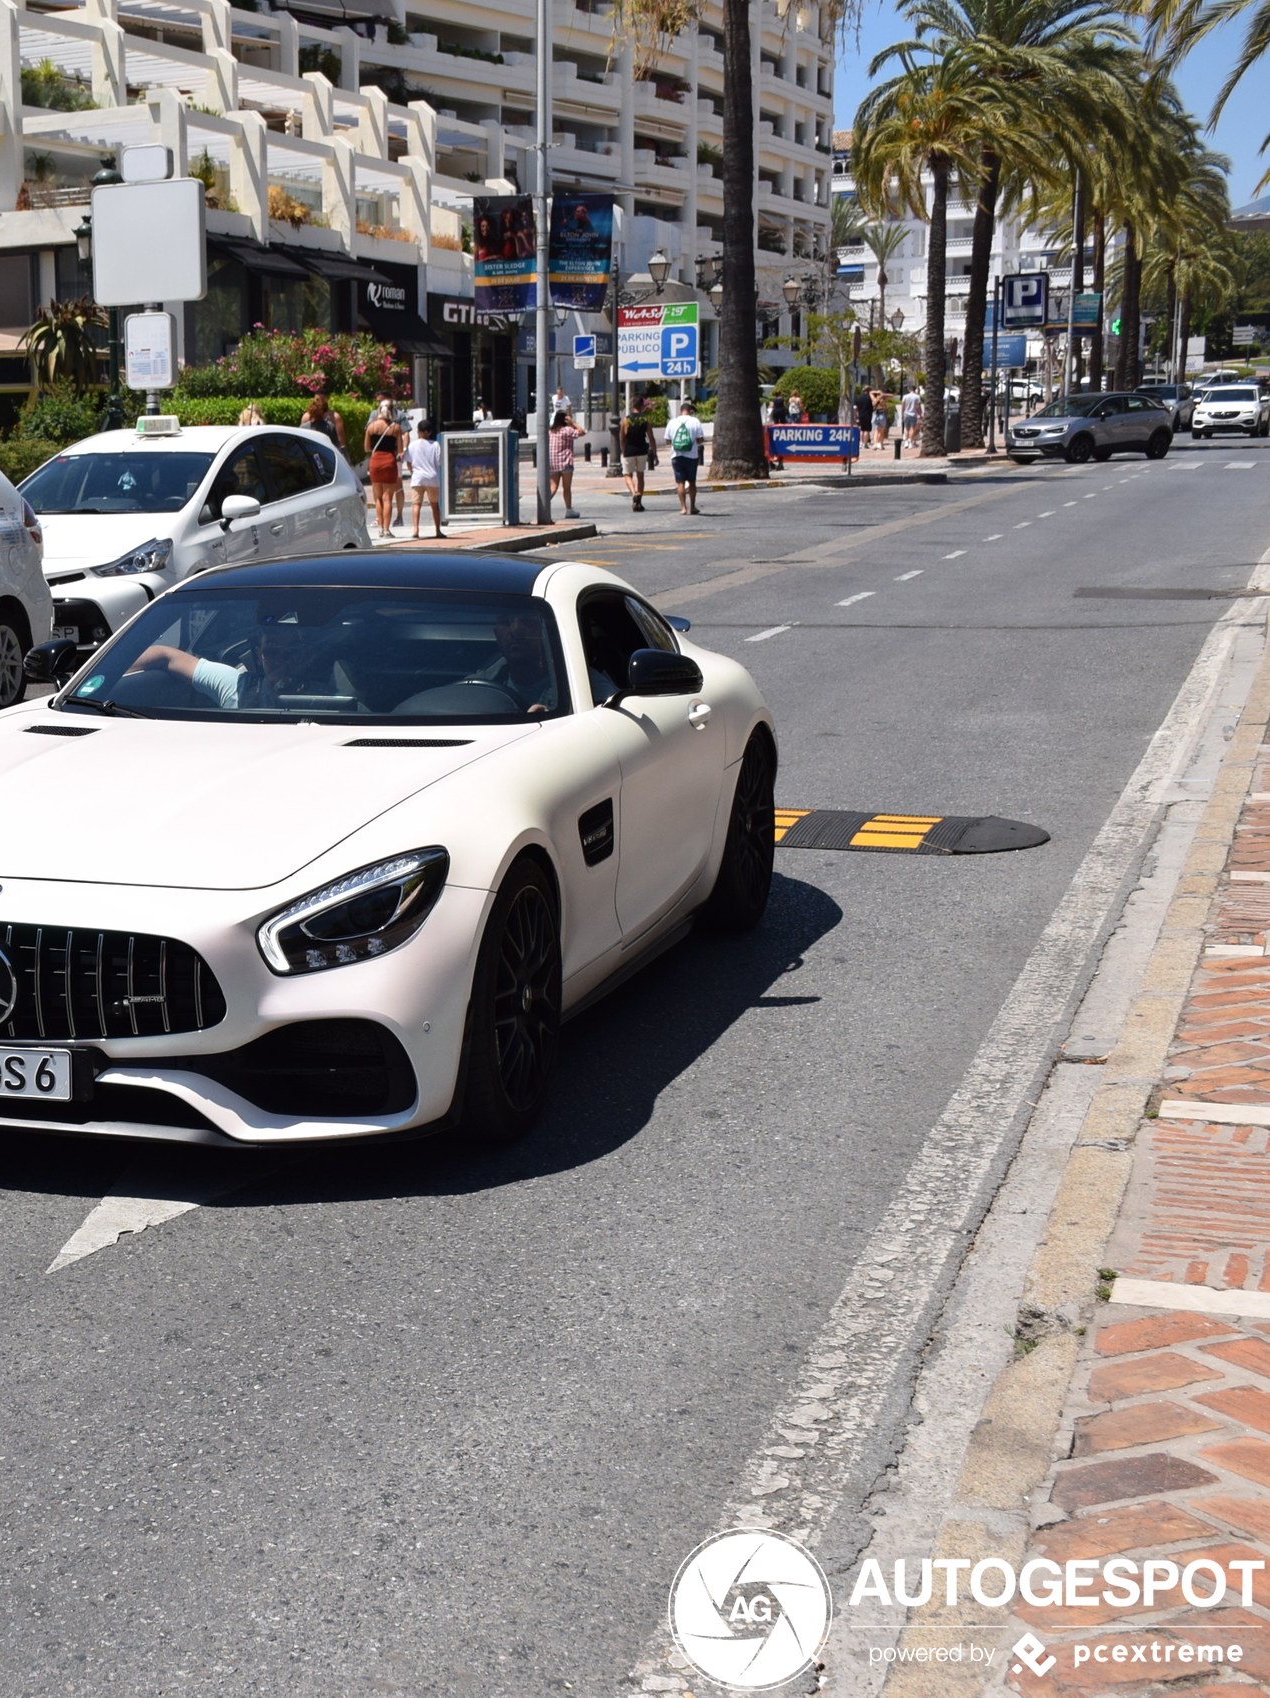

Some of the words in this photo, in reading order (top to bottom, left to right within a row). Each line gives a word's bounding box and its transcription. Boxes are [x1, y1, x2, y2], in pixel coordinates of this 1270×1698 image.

[484, 263, 504, 271] SISTER
[504, 262, 526, 270] SLEDGE
[575, 275, 598, 283] AGOSTO
[382, 286, 405, 301] roman
[670, 333, 690, 358] P
[772, 428, 823, 442] PARKING
[35, 1056, 57, 1093] 6
